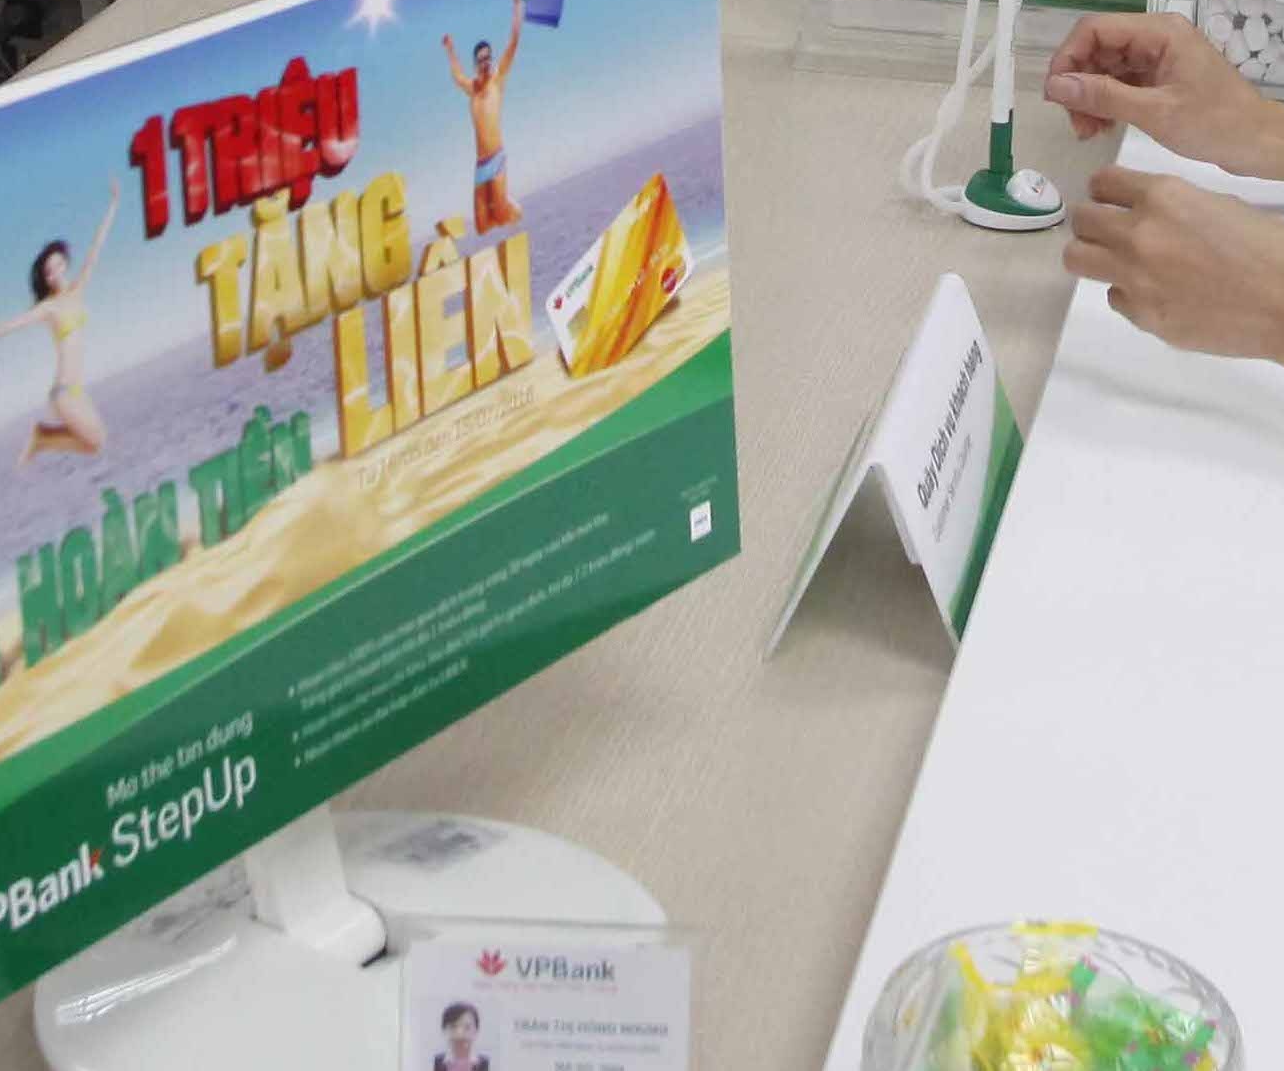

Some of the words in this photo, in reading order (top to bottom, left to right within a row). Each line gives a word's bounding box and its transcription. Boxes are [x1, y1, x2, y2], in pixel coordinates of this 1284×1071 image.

[130, 116, 170, 241] 1
[170, 56, 359, 227] TRIỆU
[195, 172, 413, 373] TẶNG
[333, 216, 536, 459] LIỀN
[15, 480, 183, 669] HOÀN
[189, 404, 314, 549] TIỀN
[111, 755, 257, 867] StepUp
[516, 955, 617, 981] VPBank
